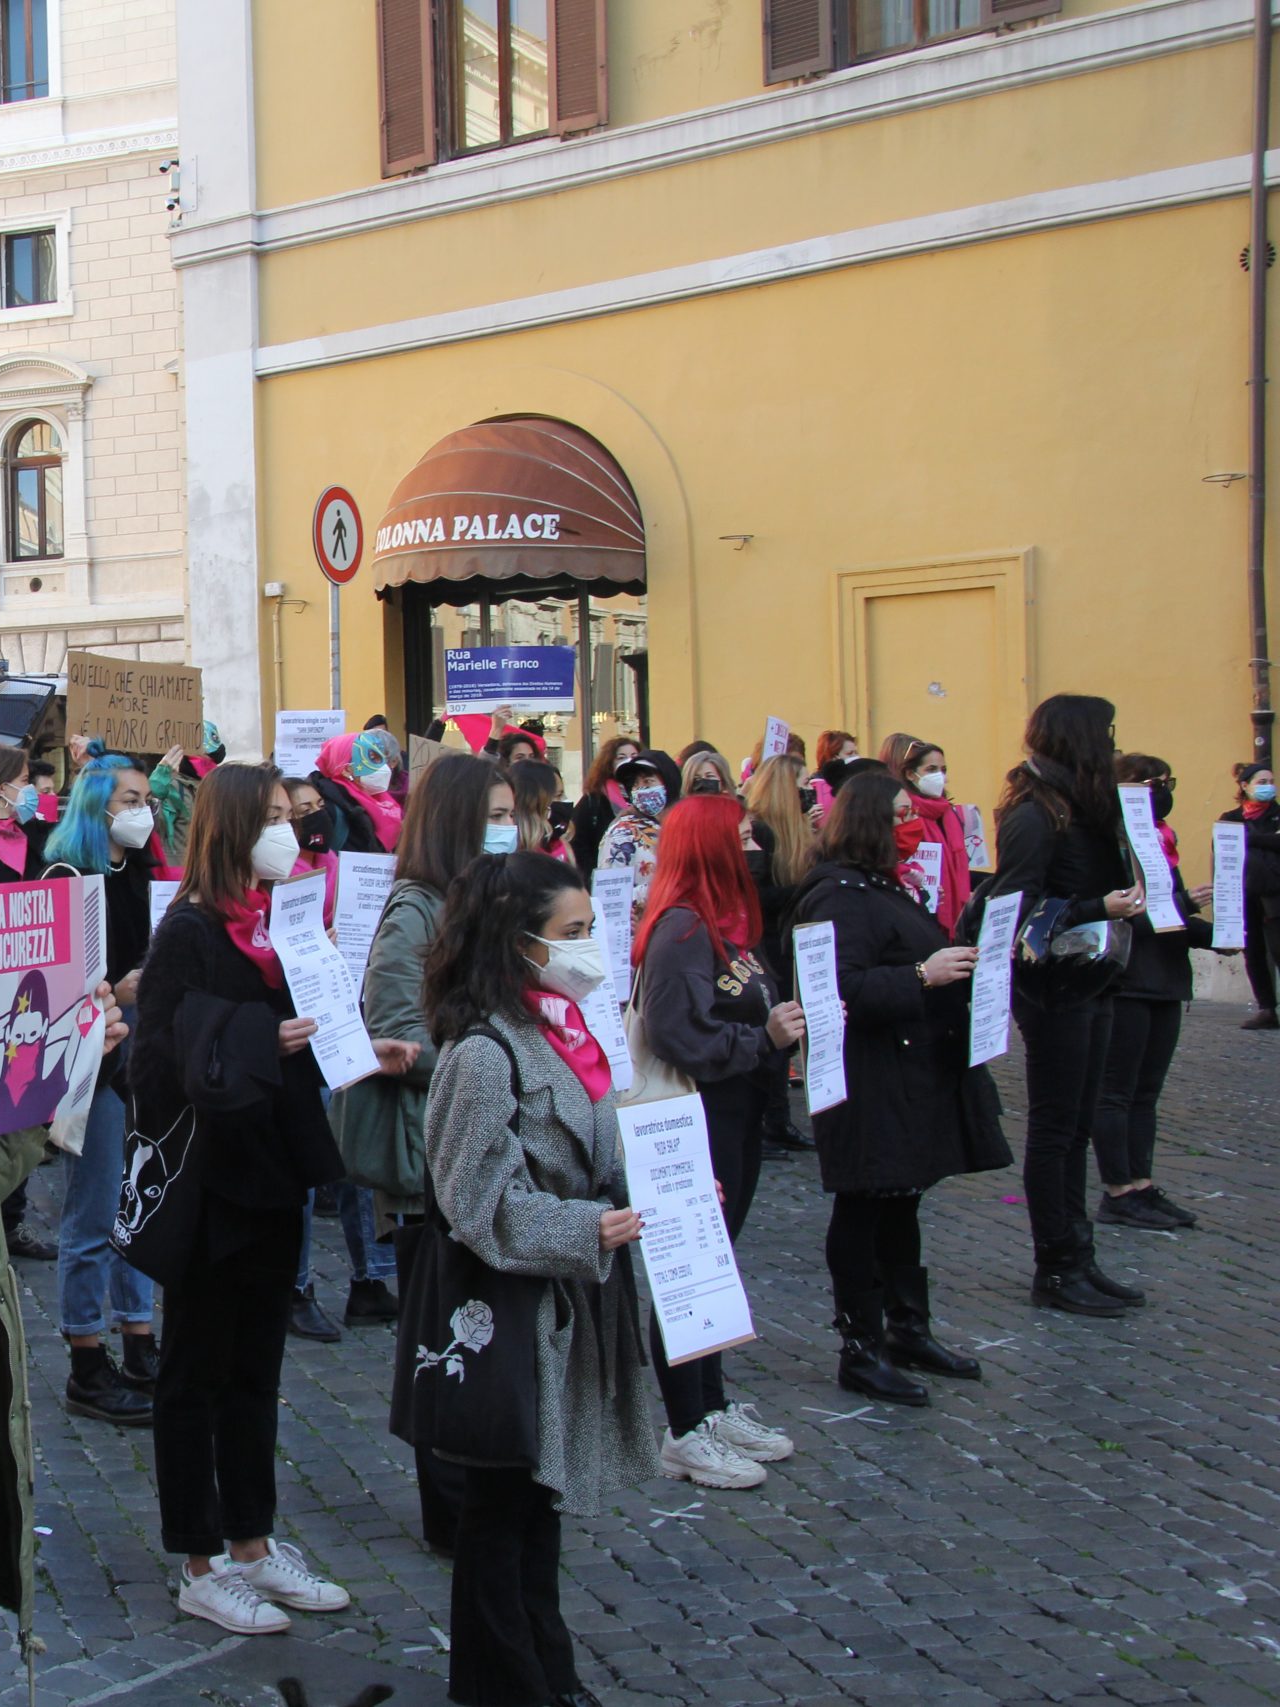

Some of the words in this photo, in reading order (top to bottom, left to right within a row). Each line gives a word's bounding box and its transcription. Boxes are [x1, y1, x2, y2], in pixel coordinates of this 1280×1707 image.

[451, 513, 560, 542] PALACE
[447, 649, 471, 660] Rua
[447, 659, 497, 671] Marielle
[501, 659, 539, 669] Franco
[70, 663, 110, 690] QUELLO
[114, 671, 134, 694] CHE
[139, 674, 194, 702] CHIAMATE
[108, 694, 149, 714] AMORE
[448, 704, 467, 713] 307
[96, 717, 148, 750] LAVORO
[155, 719, 202, 750] GRATUITO
[8, 888, 55, 928] NOSTRA
[664, 1113, 694, 1132] domestica
